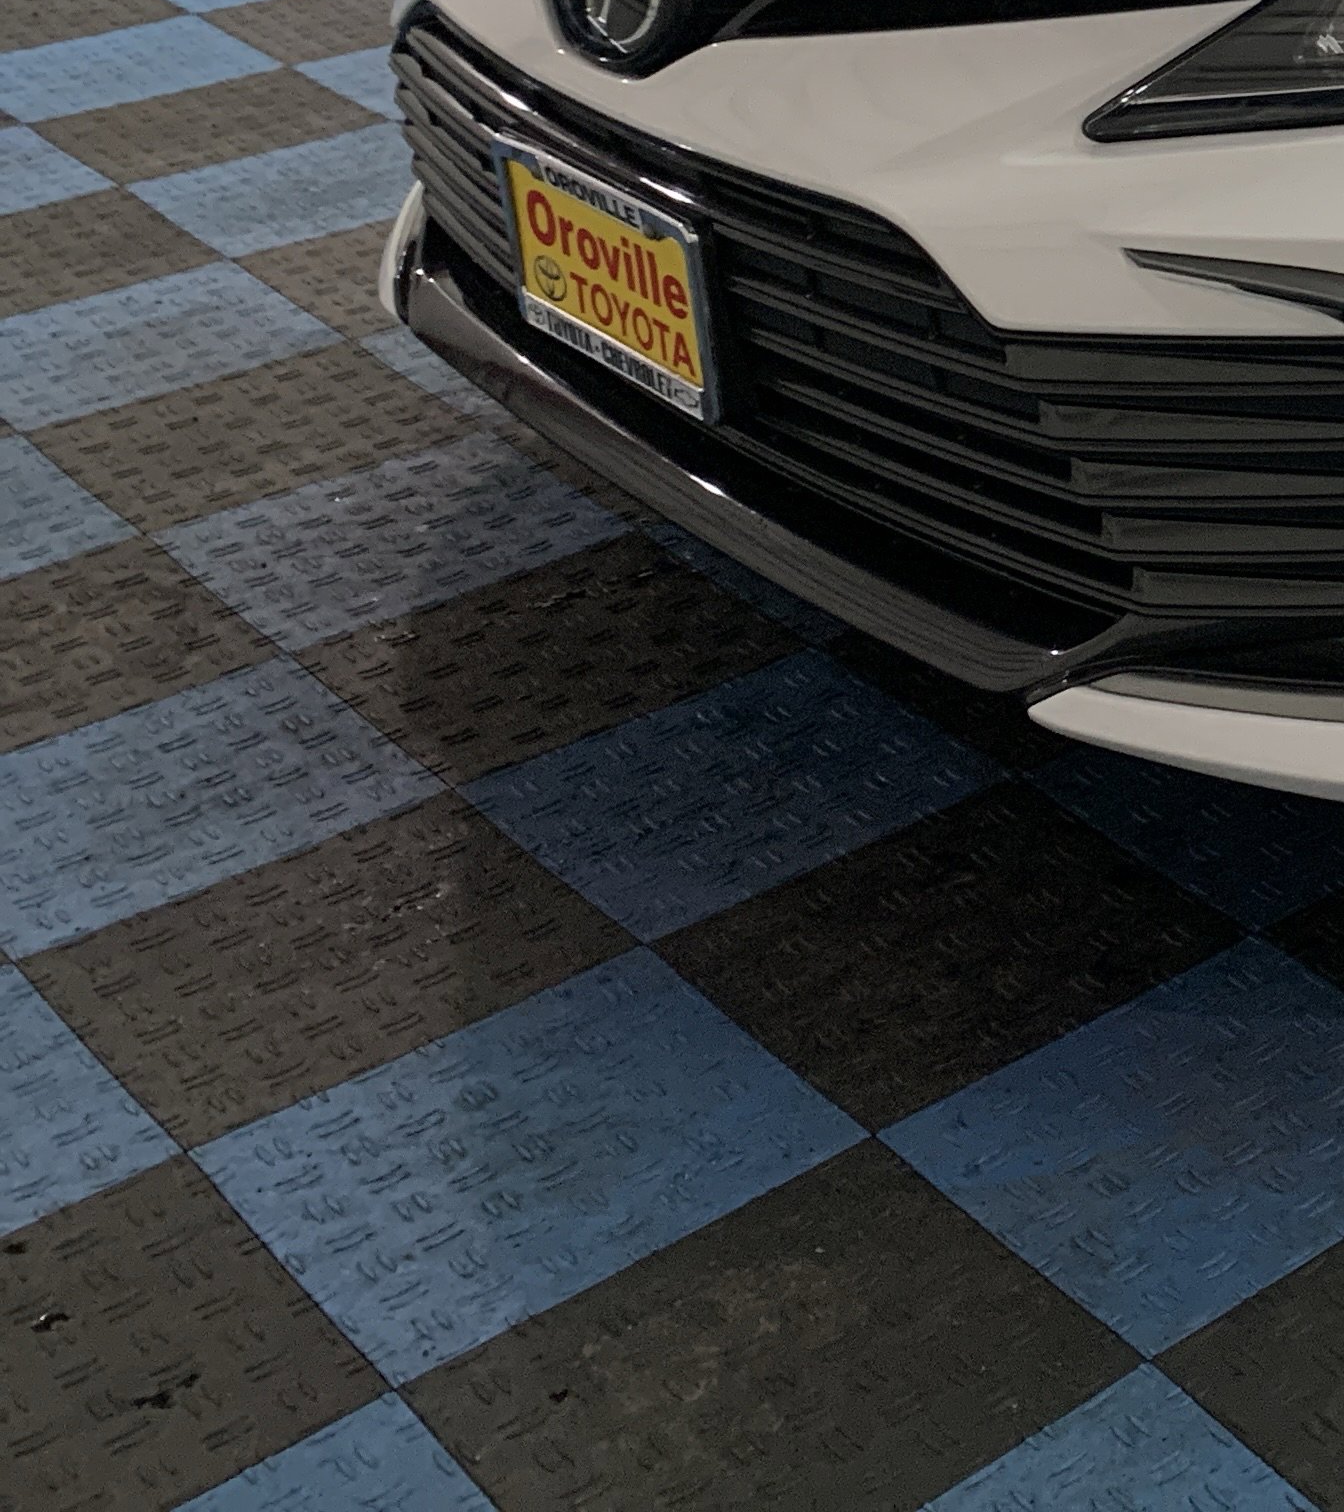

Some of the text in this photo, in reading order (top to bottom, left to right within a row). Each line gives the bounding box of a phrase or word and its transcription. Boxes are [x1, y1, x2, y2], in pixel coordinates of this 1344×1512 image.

[545, 167, 639, 228] OROVILLE
[526, 190, 689, 319] Oroville
[569, 272, 697, 376] TOYOTA
